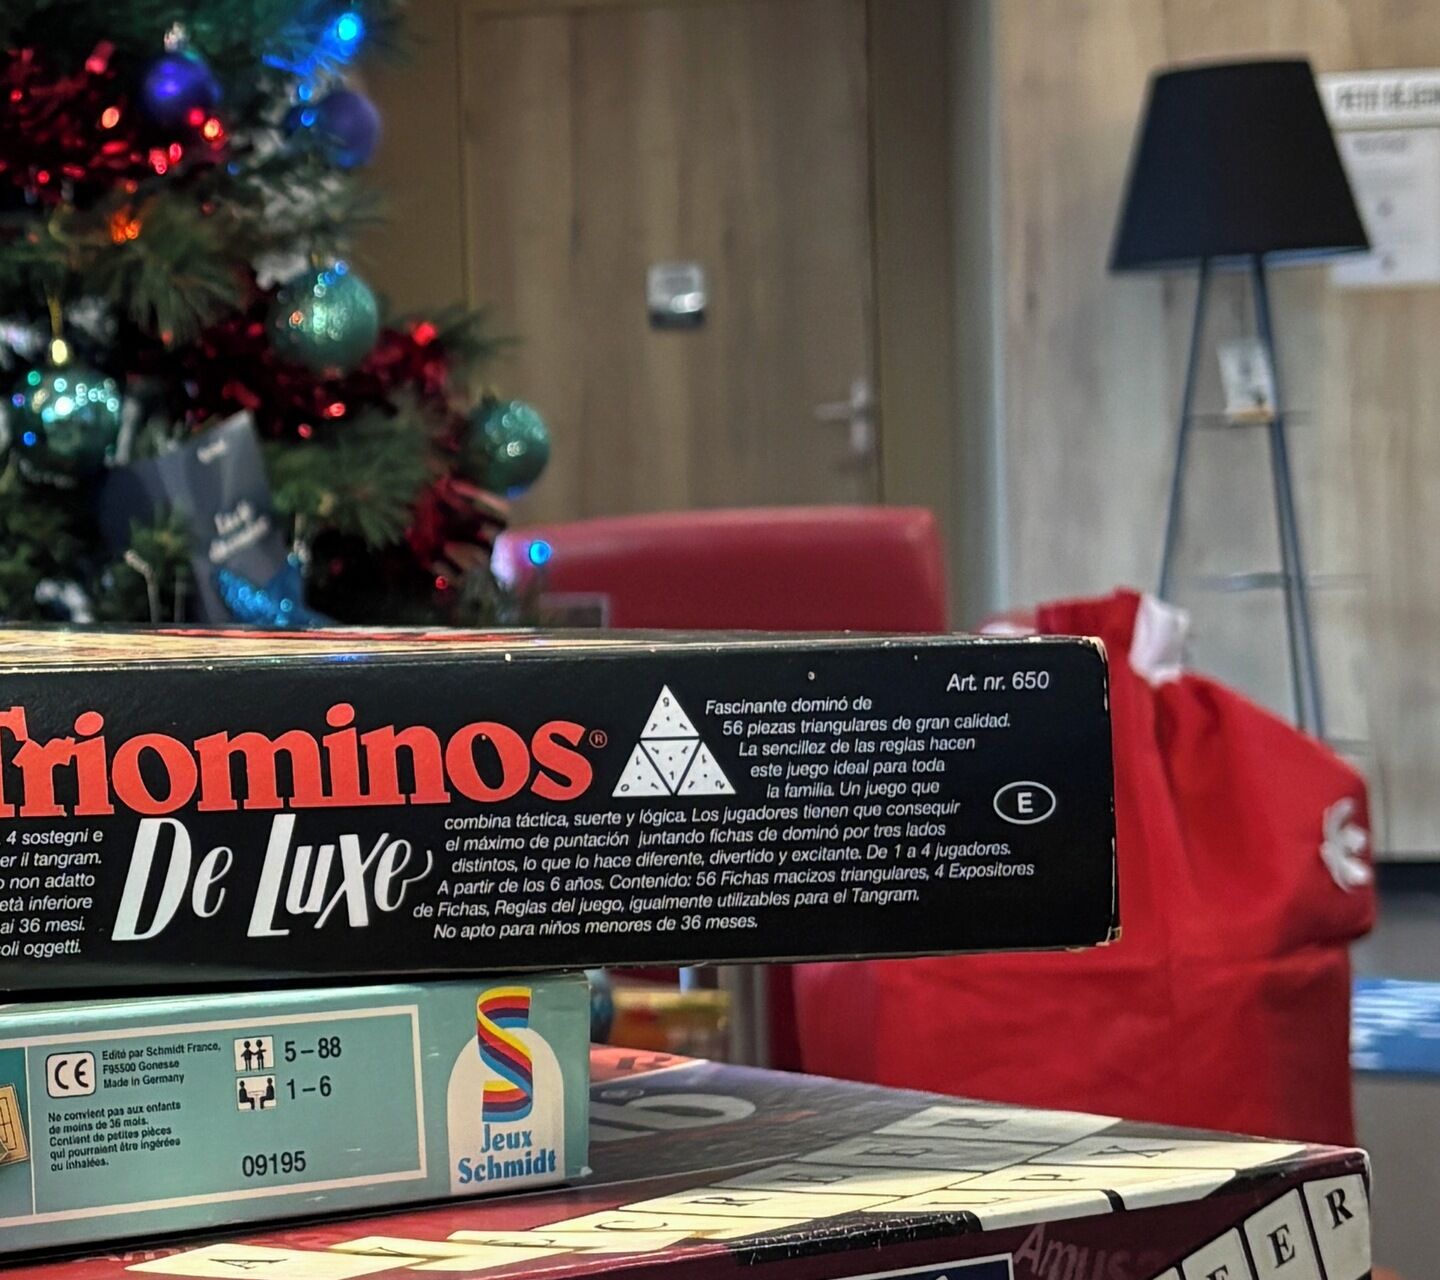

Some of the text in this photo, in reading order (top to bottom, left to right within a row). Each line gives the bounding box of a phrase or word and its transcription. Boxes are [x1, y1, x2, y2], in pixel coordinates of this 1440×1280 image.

[946, 671, 1050, 692] Art. nr. 650
[705, 695, 872, 715] Fascinante dominó de
[722, 720, 743, 736] 56
[747, 720, 796, 738] piezas
[801, 717, 888, 736] triangulares
[892, 716, 912, 731] de
[915, 717, 950, 733] gran
[739, 736, 976, 757] La sencillez de las reglas hacen
[1017, 791, 1035, 815] E
[6, 830, 17, 845] 4
[21, 828, 89, 847] sostegni
[92, 830, 104, 842] e
[20, 852, 30, 867] il
[33, 852, 102, 869] tangram.
[9, 876, 40, 889] non
[44, 872, 95, 888] adatto
[112, 814, 433, 942] De Luxe
[28, 895, 93, 911] inferiore
[0, 916, 85, 934] ai 36 mesi.
[23, 938, 81, 959] oggetti.
[481, 1123, 533, 1153] Jeux
[242, 1151, 307, 1177] 09195
[457, 1149, 557, 1184] Schmidt
